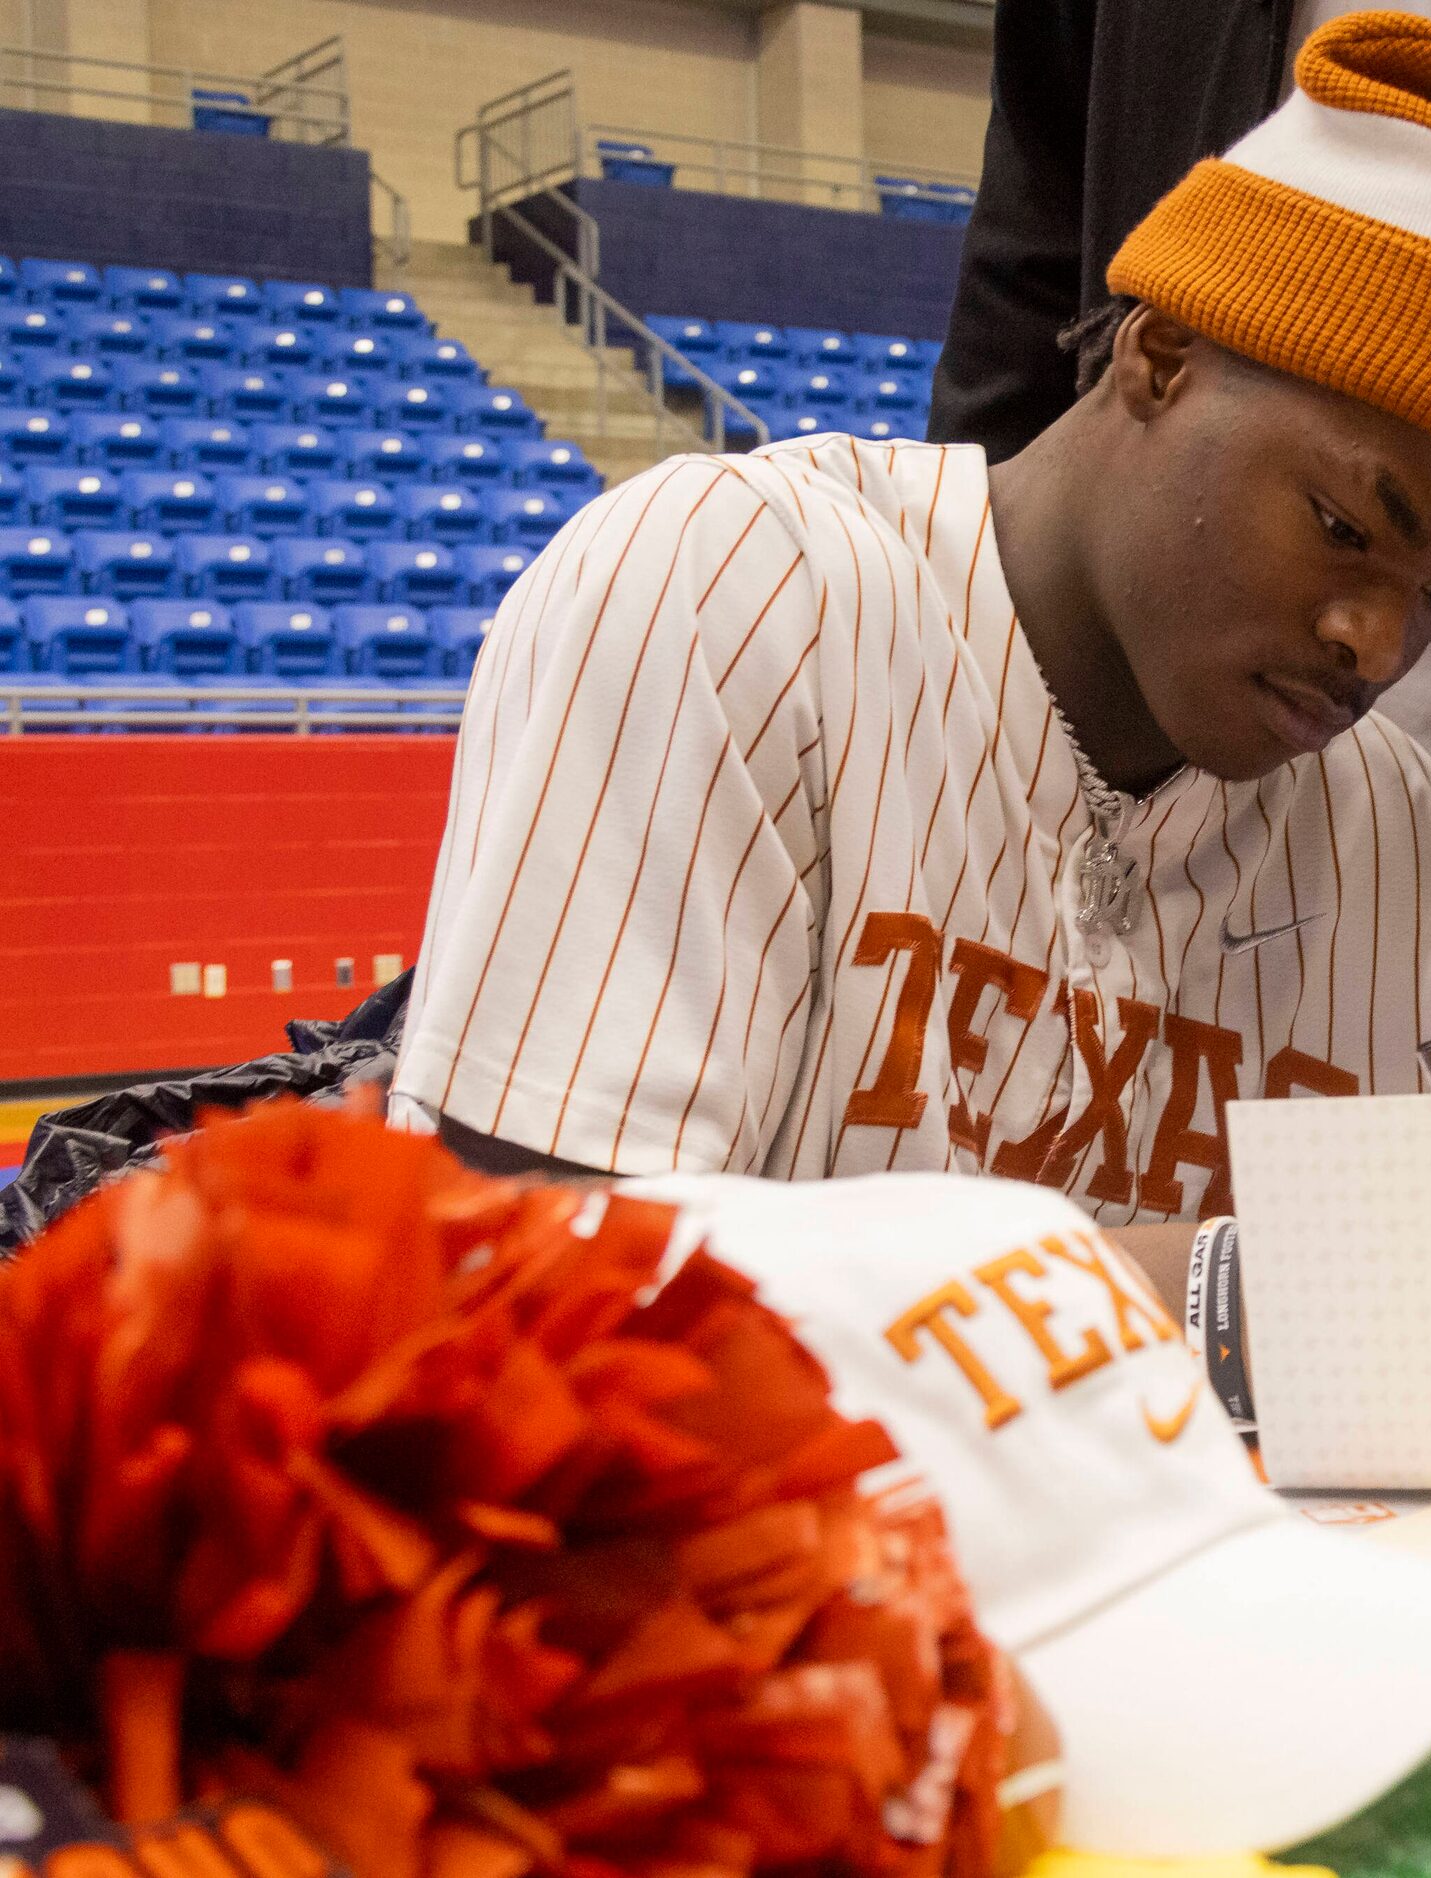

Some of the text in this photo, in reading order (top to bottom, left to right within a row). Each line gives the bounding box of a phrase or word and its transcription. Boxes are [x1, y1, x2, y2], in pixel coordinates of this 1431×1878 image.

[843, 911, 1359, 1217] TEXA
[882, 1228, 1184, 1431] TEX
[1189, 1283, 1201, 1329] ALL
[1216, 1262, 1231, 1331] LONGHORN
